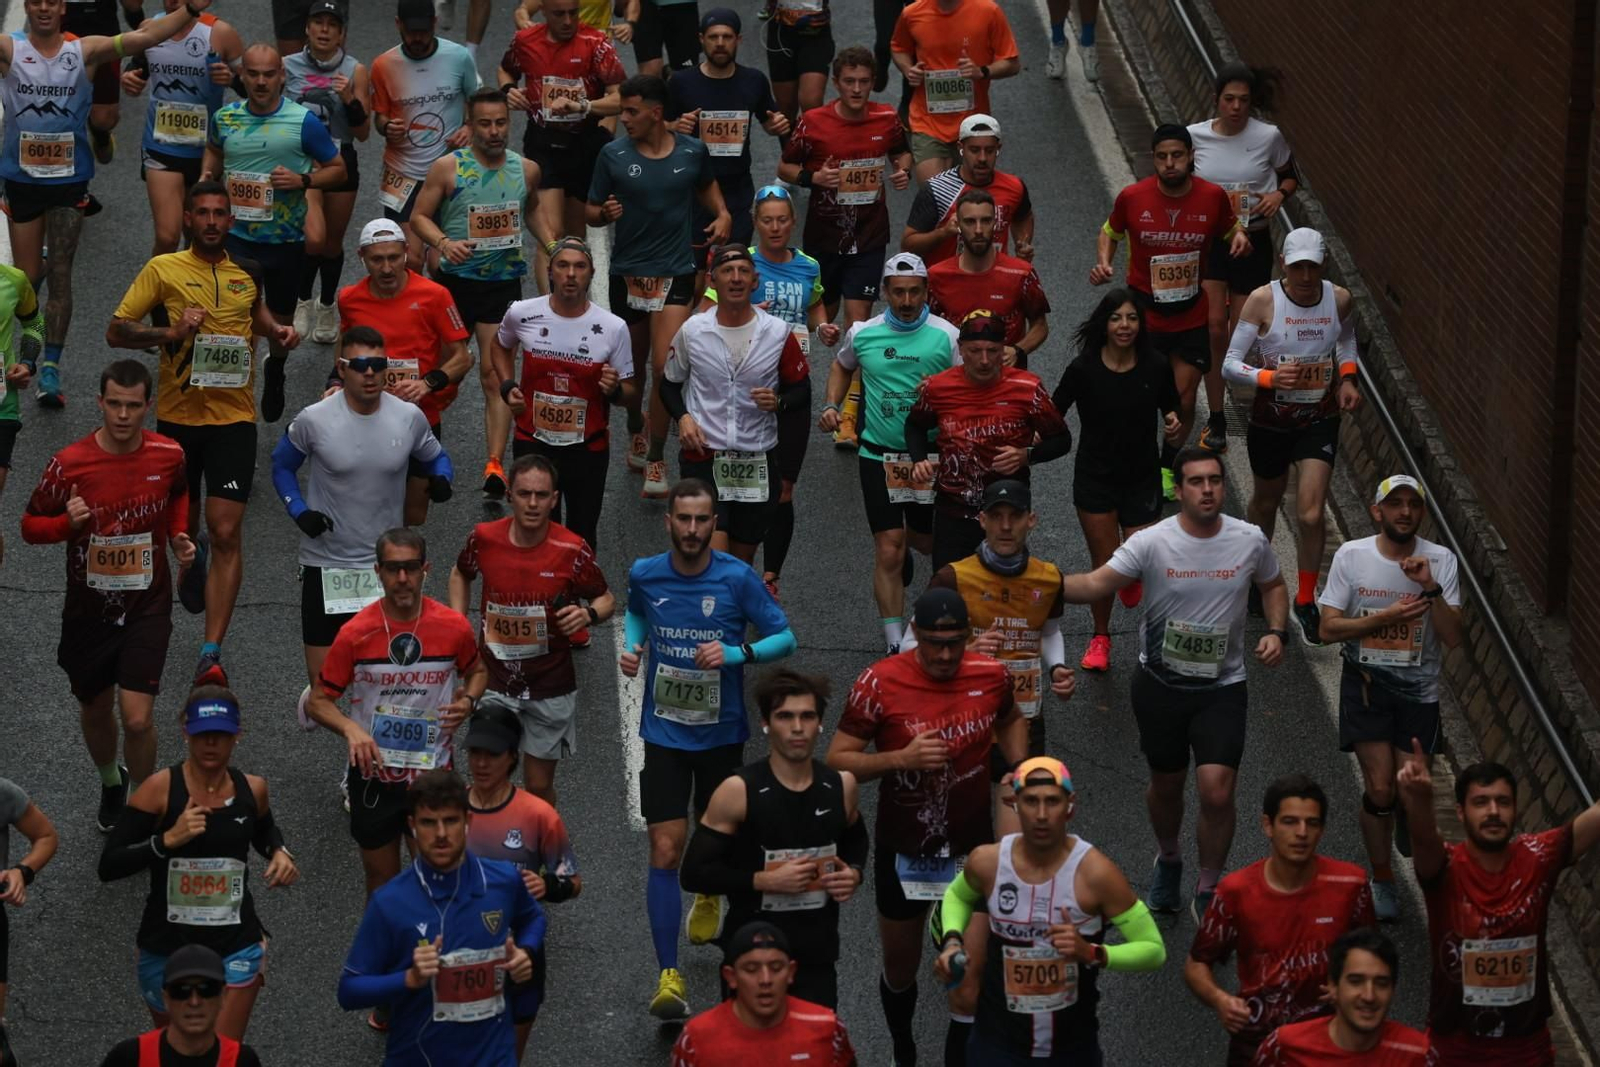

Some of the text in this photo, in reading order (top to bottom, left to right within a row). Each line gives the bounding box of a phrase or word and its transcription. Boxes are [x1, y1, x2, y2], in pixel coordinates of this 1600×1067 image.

[161, 64, 205, 77] VEREITAS
[17, 84, 76, 97] LOS VEREITA
[929, 80, 966, 95] 10086
[160, 113, 199, 129] 11908
[707, 123, 739, 137] 4514
[28, 144, 62, 158] 6012
[845, 170, 877, 184] 4875
[231, 183, 261, 200] 3986
[476, 214, 508, 230] 3983
[1140, 230, 1205, 243] ISBILYA
[1159, 267, 1192, 282] 6336
[778, 281, 803, 295] SAN
[203, 348, 239, 366] 7486
[540, 406, 573, 423] 4582
[721, 463, 754, 479] 9822
[97, 549, 137, 566] 6101
[332, 573, 372, 591] 9672
[494, 618, 531, 637] 4315
[657, 642, 697, 659] CANTAB
[1174, 633, 1213, 653] 7483
[664, 680, 704, 702] 7173
[381, 720, 423, 741] 2969
[179, 875, 228, 896] 8564
[1014, 964, 1059, 984] 5700
[1475, 955, 1522, 976] 6216
[453, 968, 487, 991] 760
